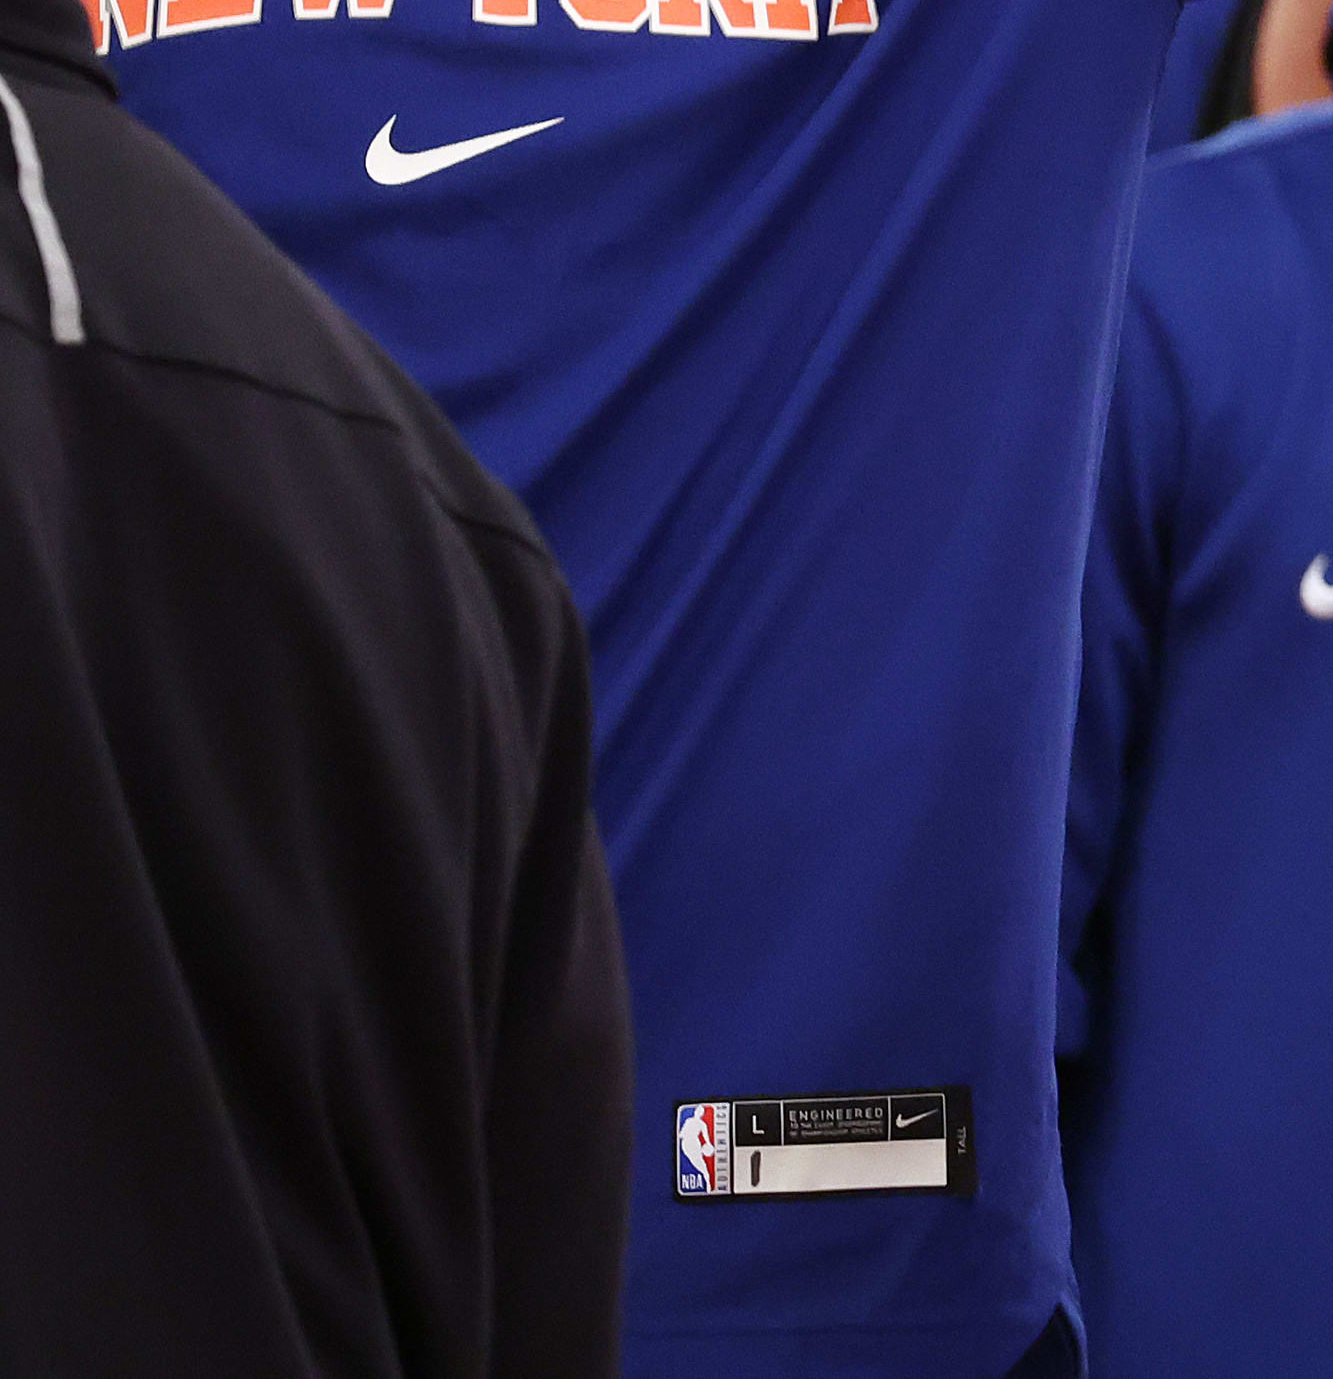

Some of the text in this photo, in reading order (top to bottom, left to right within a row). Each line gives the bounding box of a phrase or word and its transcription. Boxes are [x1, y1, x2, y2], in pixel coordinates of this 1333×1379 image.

[789, 1107, 883, 1122] ENGINEERED
[752, 1115, 764, 1135] L
[681, 1173, 703, 1189] NBA
